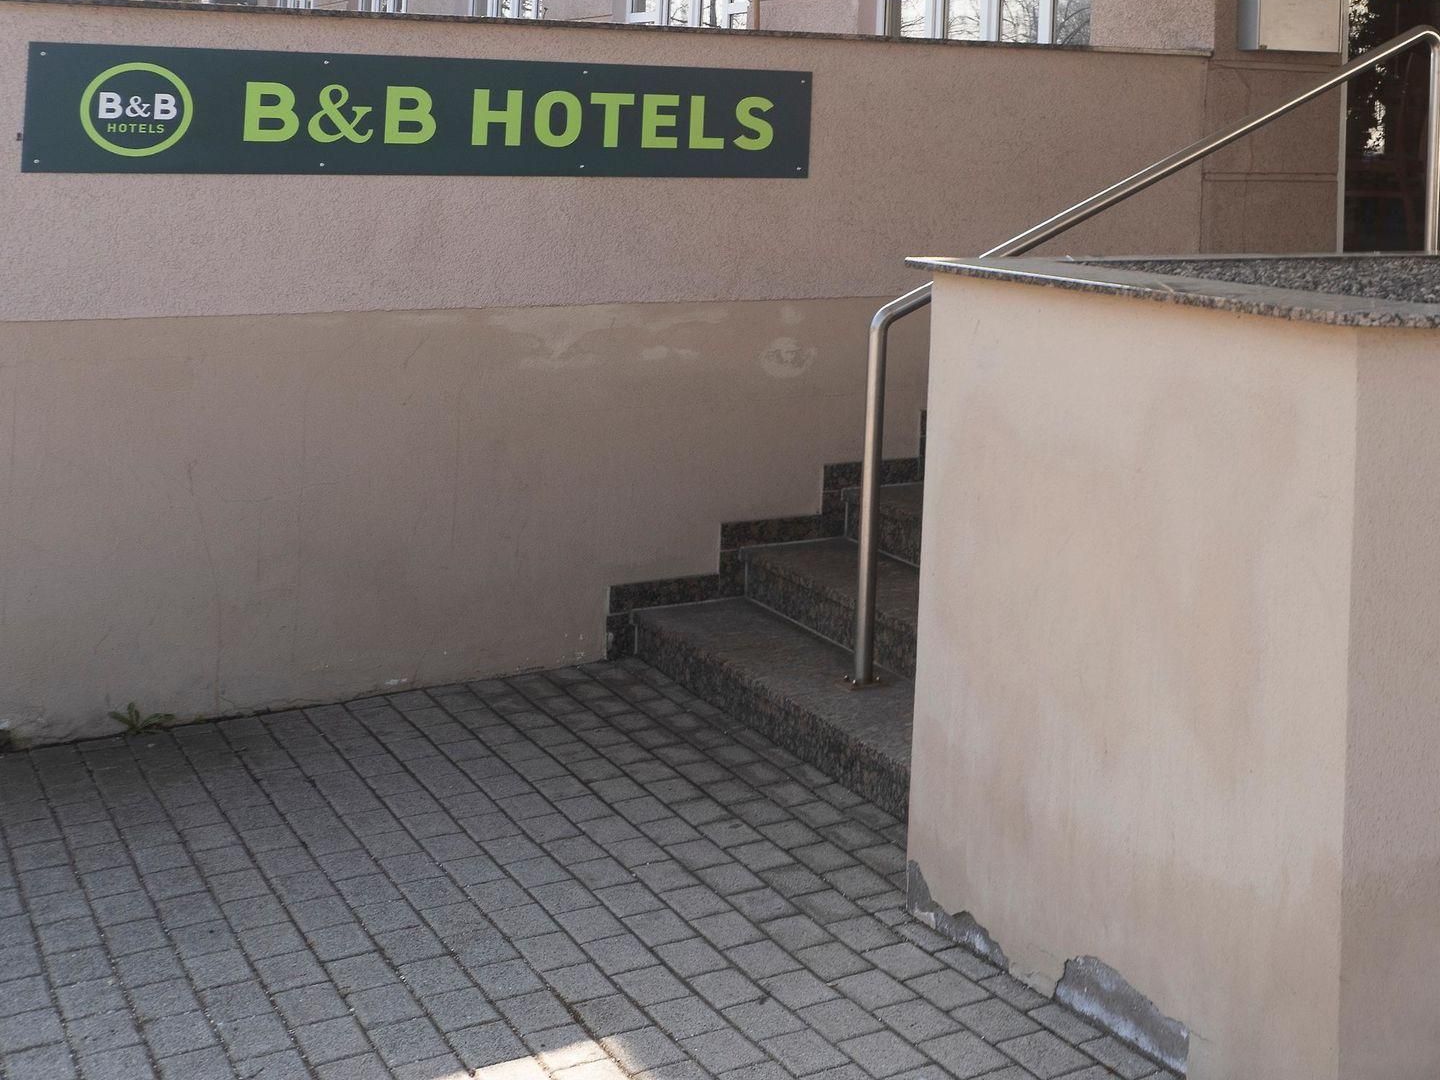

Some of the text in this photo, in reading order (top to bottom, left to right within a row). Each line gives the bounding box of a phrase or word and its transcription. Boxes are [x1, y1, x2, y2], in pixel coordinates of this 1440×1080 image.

[98, 91, 178, 120] B&B
[243, 81, 775, 151] B&B HOTELS
[106, 123, 165, 134] HOTELS
